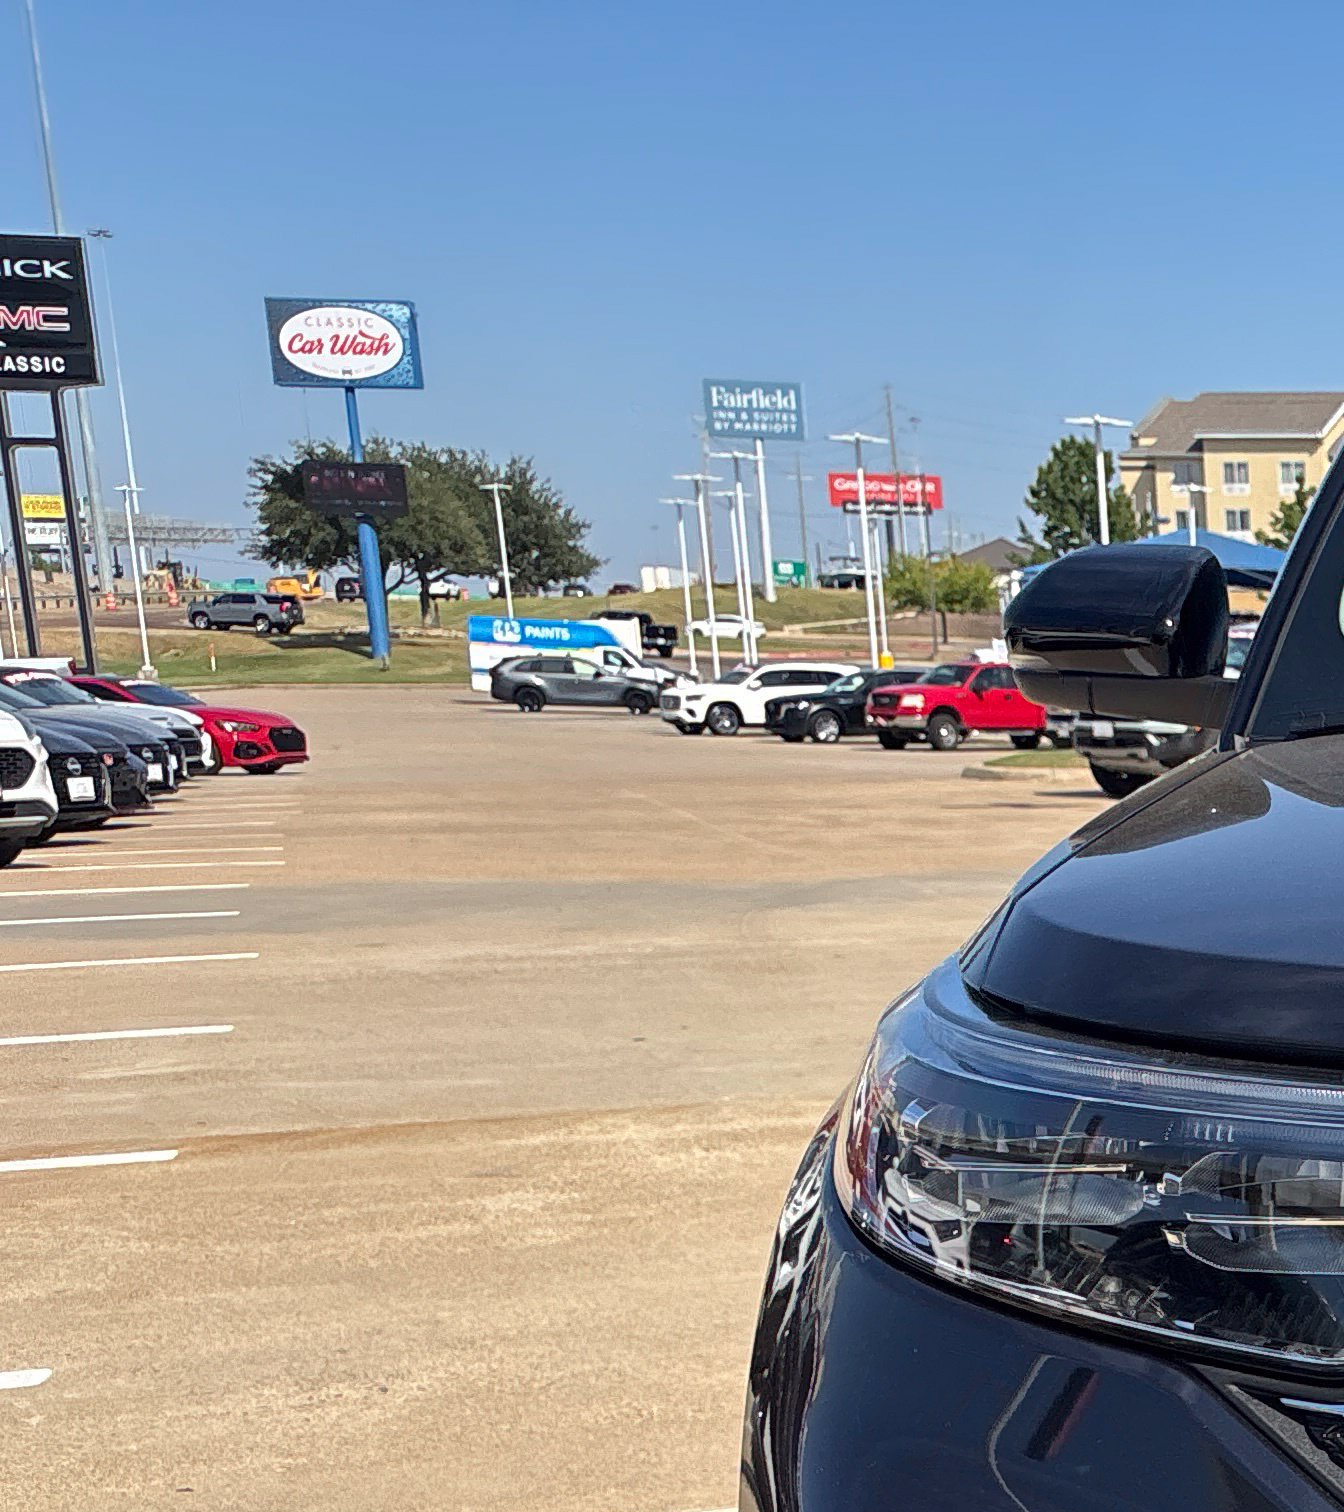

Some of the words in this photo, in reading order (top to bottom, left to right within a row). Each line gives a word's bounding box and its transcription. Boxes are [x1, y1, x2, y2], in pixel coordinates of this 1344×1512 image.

[0, 259, 73, 279] ICK
[0, 305, 71, 331] MC
[304, 316, 374, 329] CLASSIC
[287, 333, 325, 355] Car
[329, 329, 396, 357] Wash
[0, 355, 66, 373] ASSIC
[711, 385, 797, 411] Fairfield
[713, 410, 736, 419] INN
[753, 411, 798, 423] SUITES
[714, 421, 730, 431] BY
[734, 422, 797, 434] MARRIOTT
[524, 625, 570, 641] PAINTS
